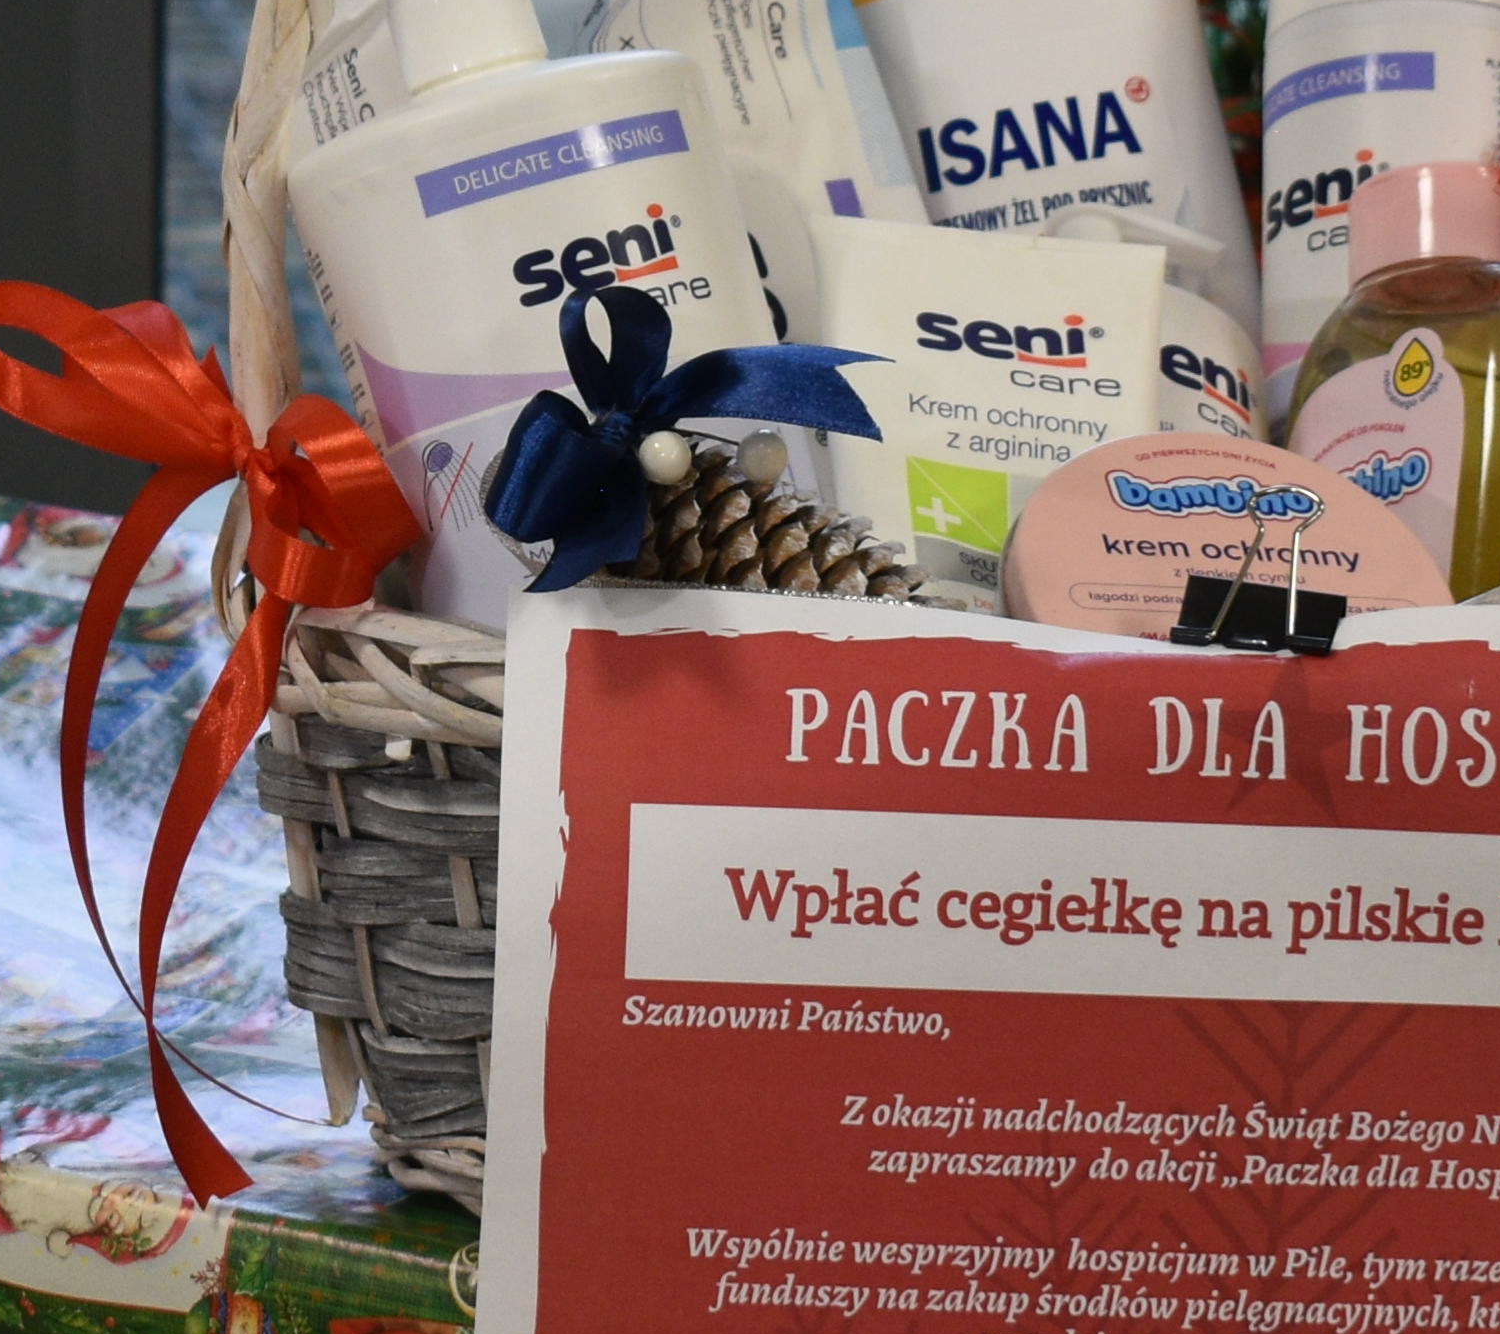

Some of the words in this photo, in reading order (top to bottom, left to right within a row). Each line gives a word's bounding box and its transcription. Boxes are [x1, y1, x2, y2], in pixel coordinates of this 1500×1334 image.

[767, 7, 787, 60] Care
[453, 152, 552, 196] DELICATE
[557, 125, 664, 166] CLEANSING
[917, 91, 1143, 194] ISANA
[1010, 370, 1121, 398] care
[908, 394, 979, 425] Krem
[985, 407, 1108, 443] ochronny
[946, 432, 961, 449] z
[1111, 473, 1316, 517] bambino
[1101, 533, 1189, 559] krem
[1200, 538, 1360, 574] ochronny
[785, 687, 1089, 773] PACZKA
[1147, 695, 1287, 780] DLA
[724, 867, 921, 939] Wpłać
[936, 877, 1183, 949] cegiełkę
[1197, 898, 1273, 939] na
[1285, 885, 1485, 955] pilskie
[622, 994, 792, 1031] Szanowni
[797, 999, 951, 1041] Państwo,
[840, 1095, 868, 1126] Z
[871, 1093, 976, 1138] okazji
[982, 1097, 1236, 1146] nadchodzących
[1242, 1100, 1343, 1150] Świąt
[1346, 1110, 1465, 1153] Bożego
[867, 1150, 1077, 1189] zapraszamy
[1088, 1146, 1130, 1181] do
[1135, 1148, 1218, 1192] akcji
[1365, 1154, 1420, 1189] dla
[686, 1227, 846, 1269] Wspólnie
[851, 1235, 1056, 1279] wesprzyjmy
[1067, 1237, 1240, 1283] hospicjum
[1247, 1254, 1277, 1278] w
[1281, 1244, 1354, 1284] Pile,
[1362, 1252, 1427, 1290] tym
